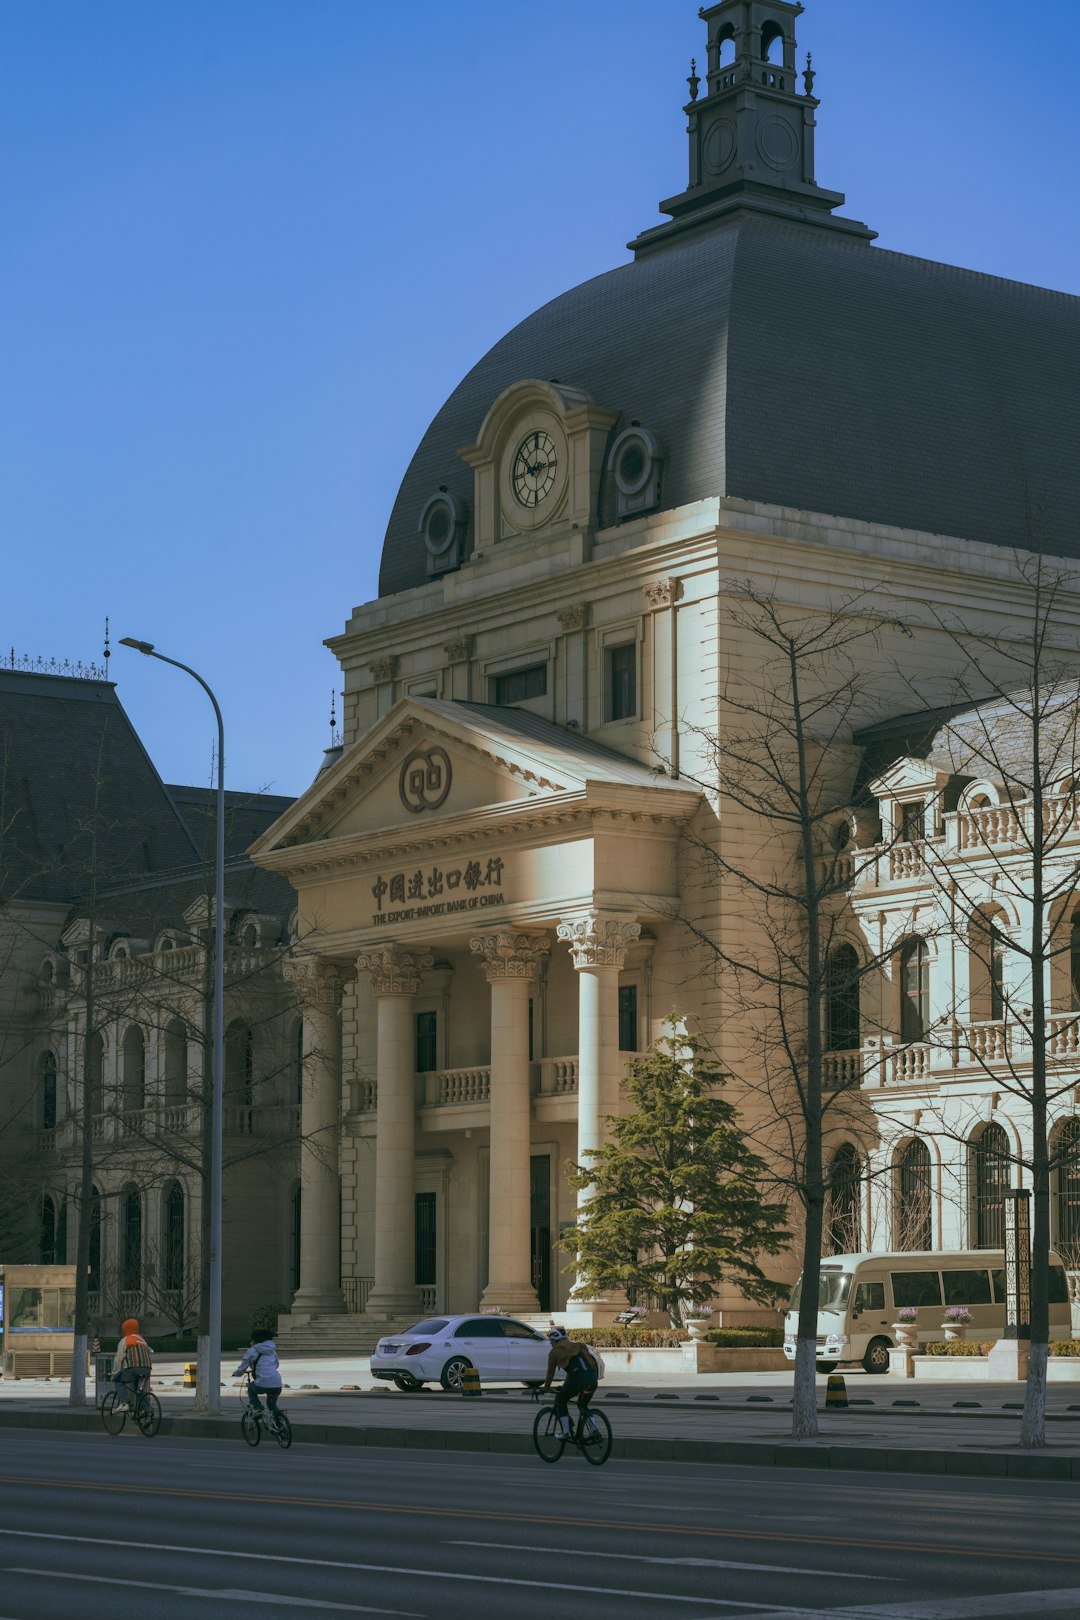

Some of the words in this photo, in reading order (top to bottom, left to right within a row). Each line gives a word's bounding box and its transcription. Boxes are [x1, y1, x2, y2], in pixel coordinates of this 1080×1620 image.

[372, 914, 386, 925] THE
[388, 903, 446, 922] EXPORT-IMPORT
[447, 898, 467, 912] BANK
[469, 896, 479, 908] OF
[480, 893, 504, 906] CHINA
